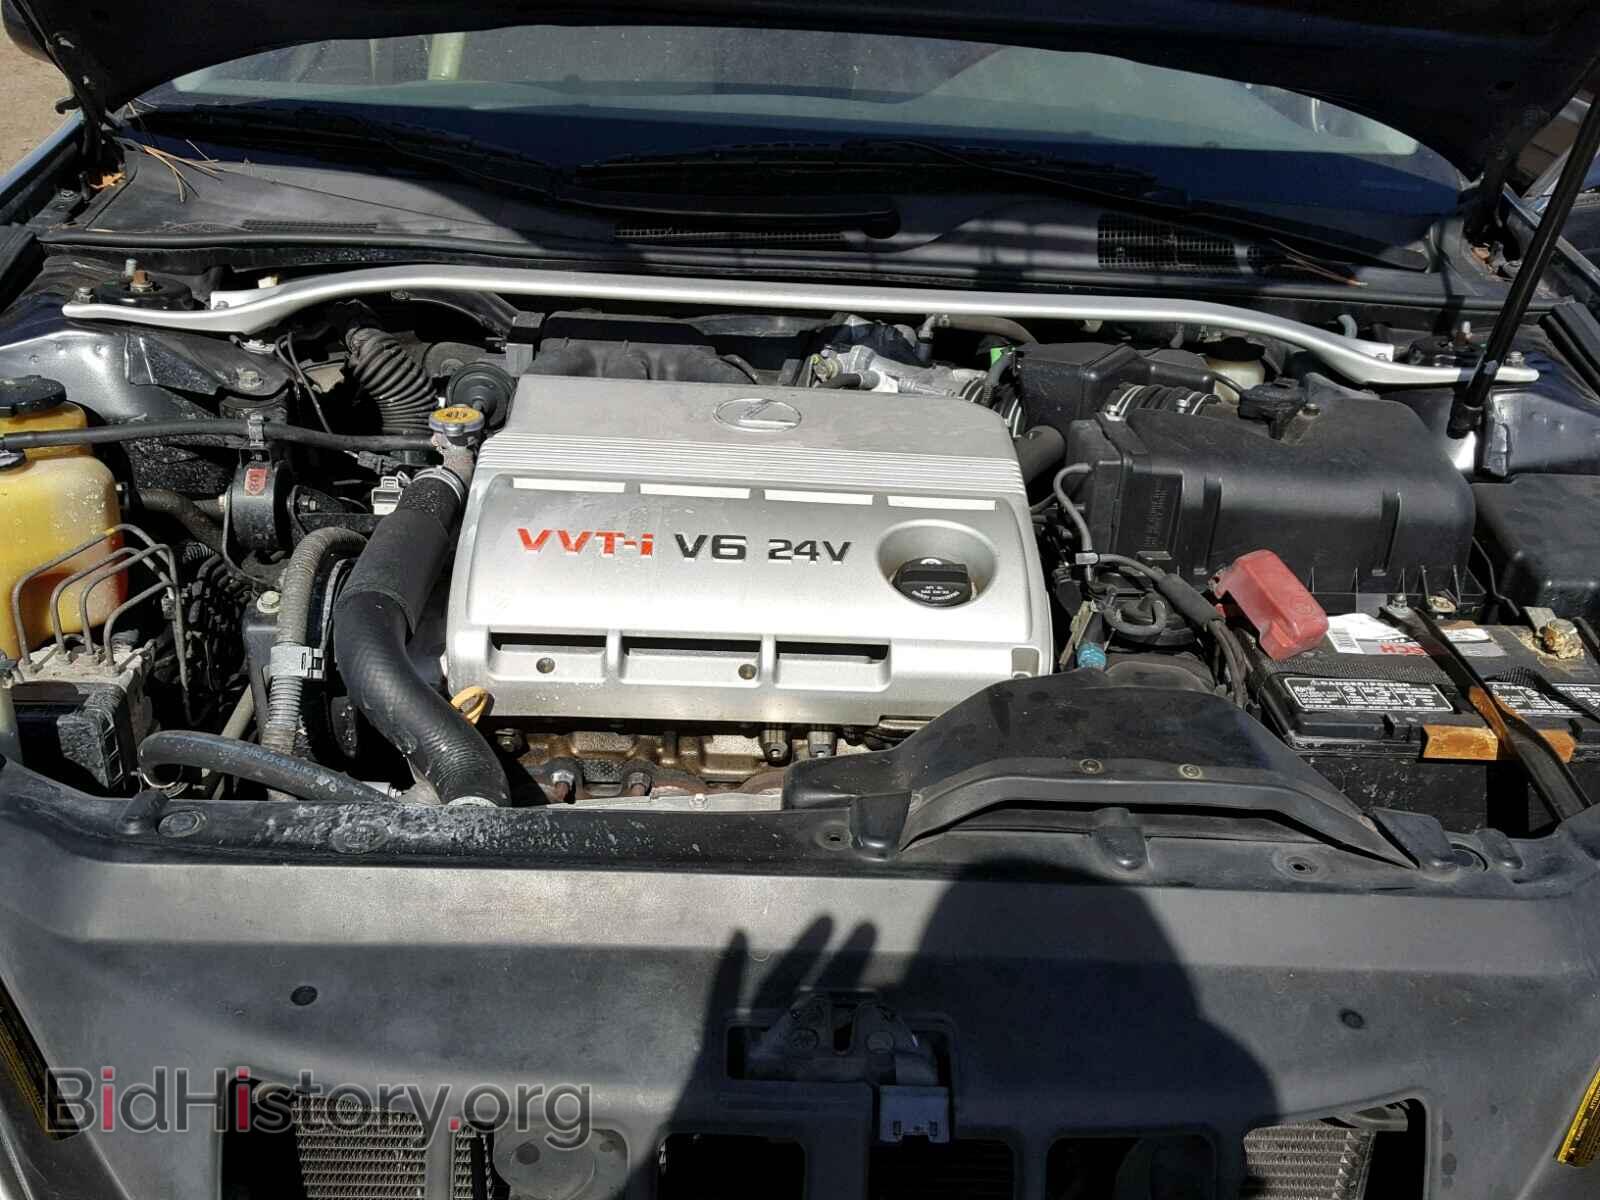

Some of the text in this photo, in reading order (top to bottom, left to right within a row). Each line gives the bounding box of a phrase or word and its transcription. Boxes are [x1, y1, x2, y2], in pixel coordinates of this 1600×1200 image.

[517, 528, 852, 564] VVT-i V6 24V
